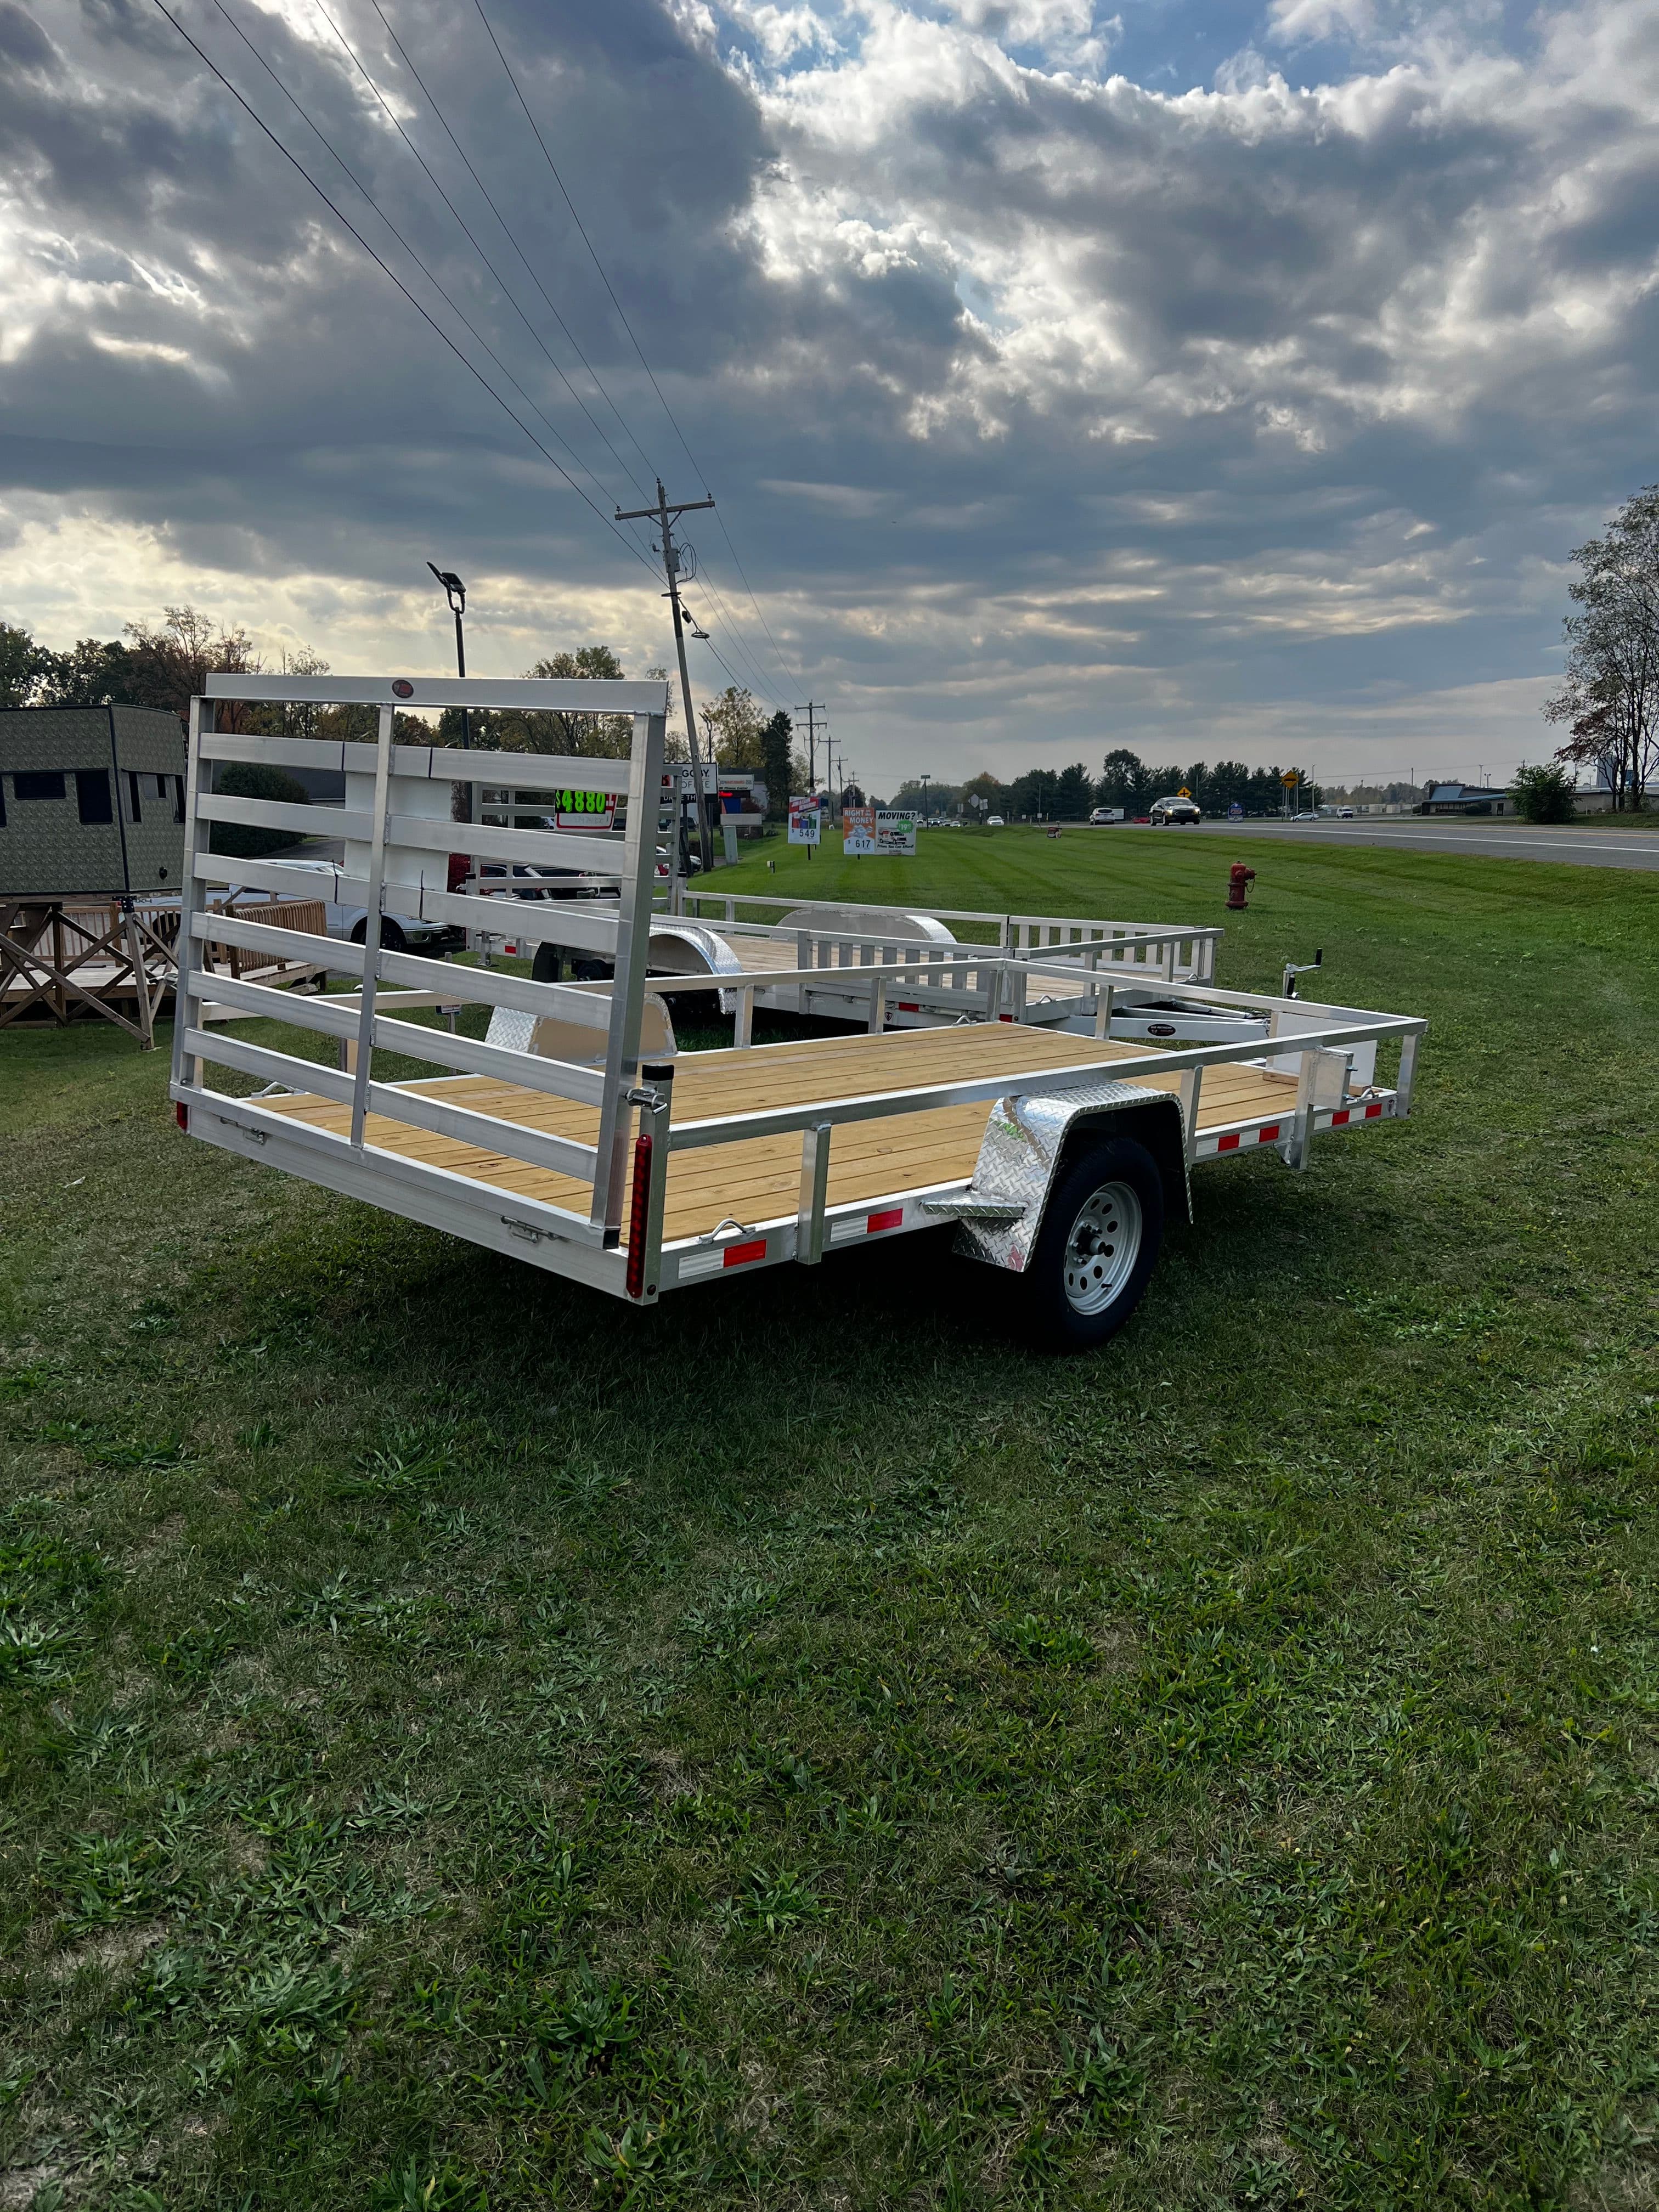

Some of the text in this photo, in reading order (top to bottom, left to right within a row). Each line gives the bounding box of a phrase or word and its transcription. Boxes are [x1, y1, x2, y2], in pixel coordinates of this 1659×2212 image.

[878, 811, 916, 820] MOVING?
[799, 829, 815, 838] 549
[855, 839, 871, 848] 617
